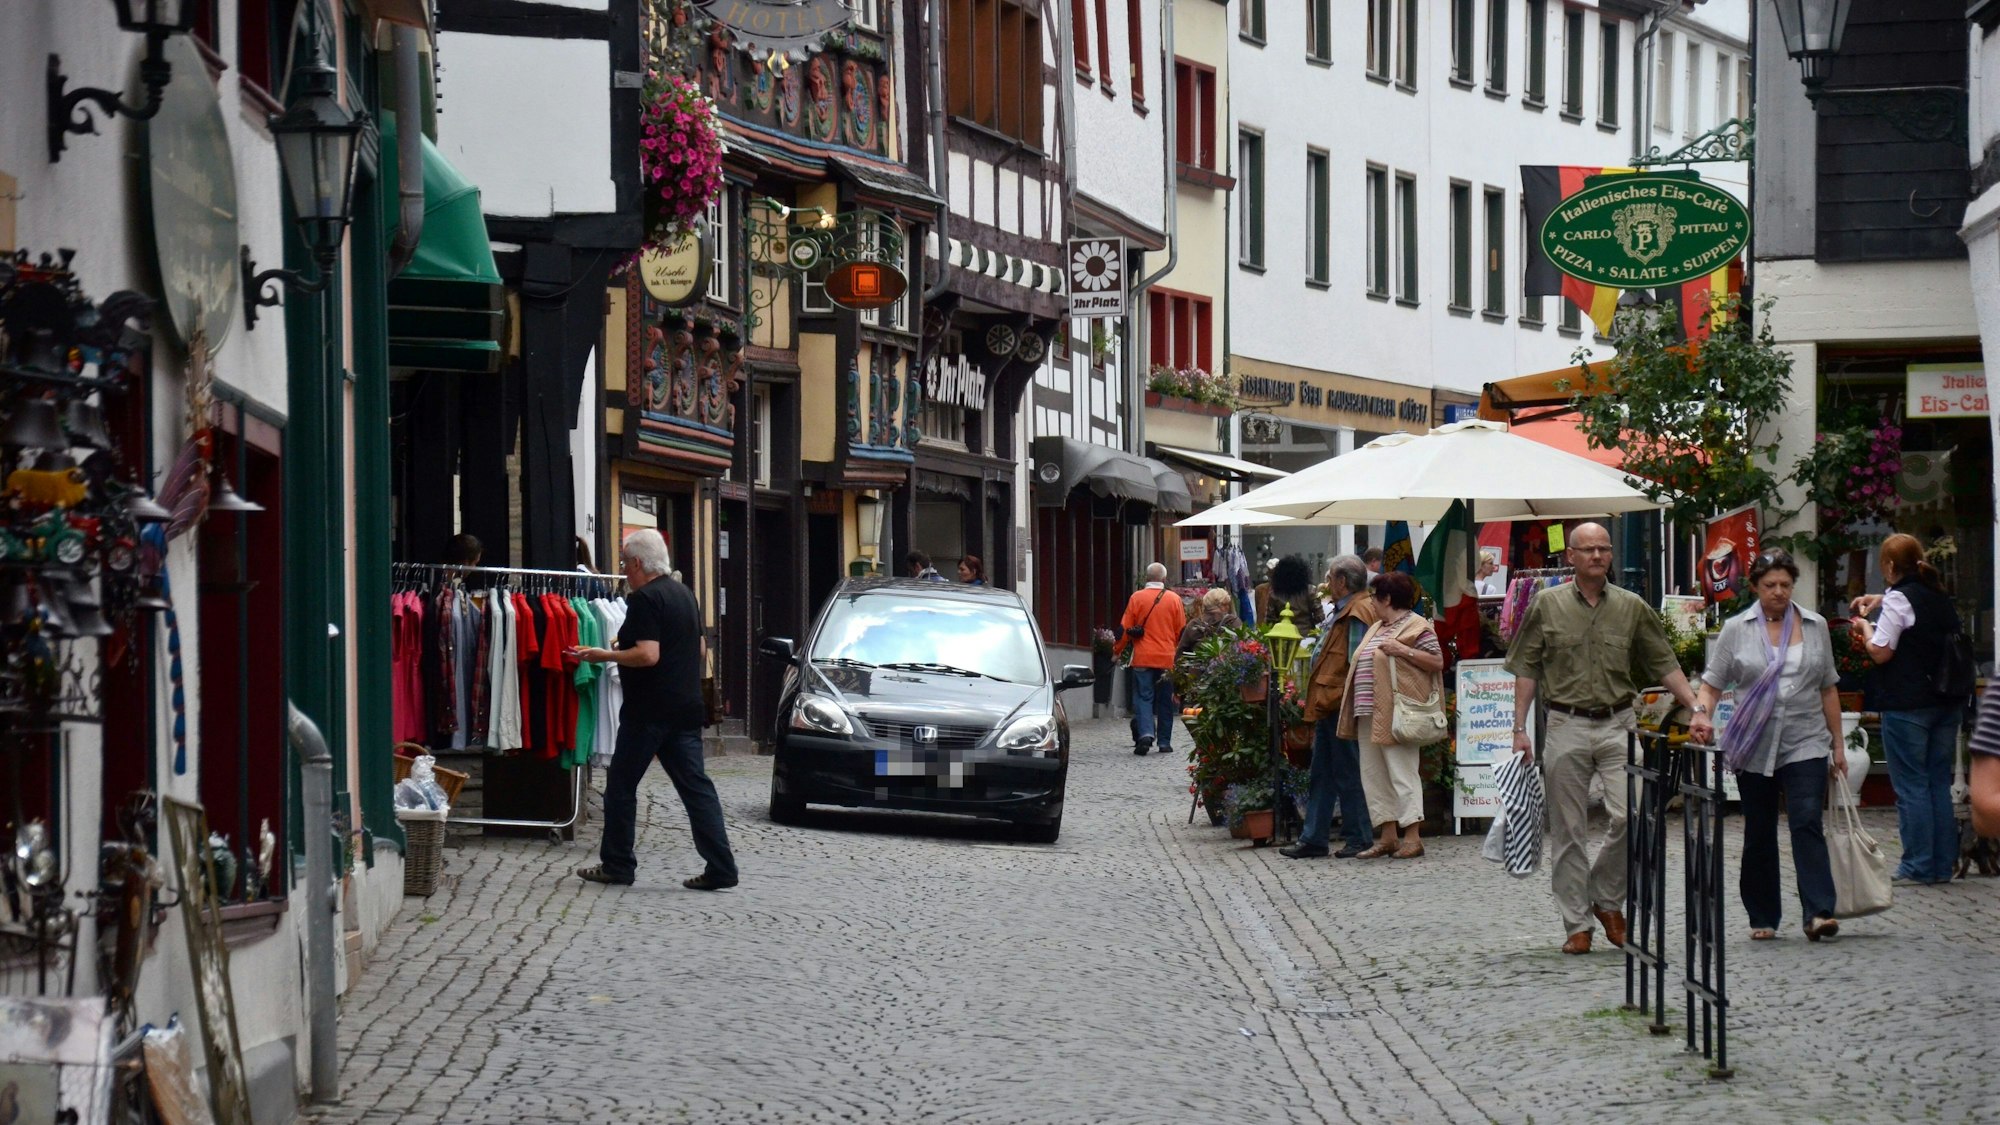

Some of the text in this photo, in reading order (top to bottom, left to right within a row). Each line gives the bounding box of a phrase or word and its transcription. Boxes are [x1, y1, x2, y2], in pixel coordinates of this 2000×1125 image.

[726, 2, 826, 33] HOTEL
[1559, 184, 1729, 224] Italienisches Eis-Café
[1563, 221, 1729, 241] CARLO PITTAU
[1553, 234, 1740, 280] PIZZA SALATE SUPPEN
[1073, 296, 1120, 309] Ihr Platz
[936, 353, 986, 411] Ihr Platz
[1942, 374, 1987, 389] Italie
[1470, 719, 1515, 729] MACCHIA
